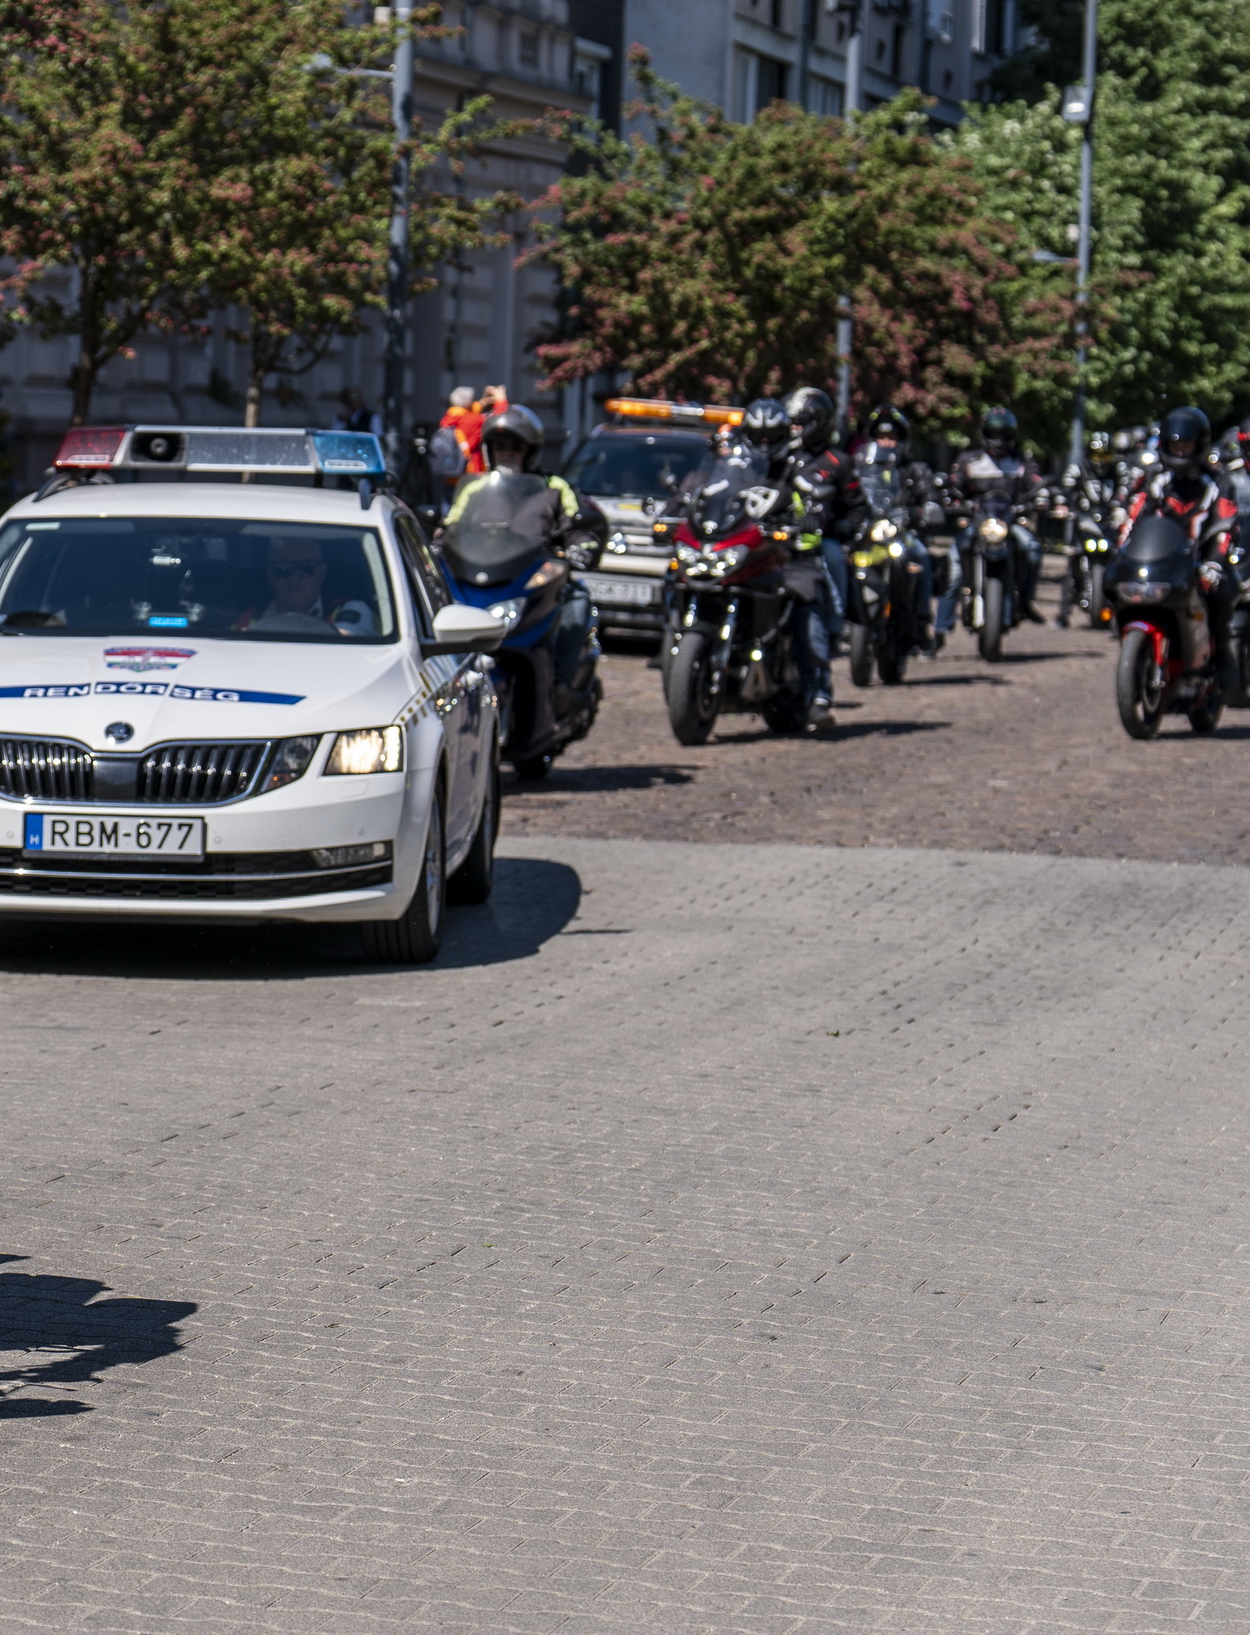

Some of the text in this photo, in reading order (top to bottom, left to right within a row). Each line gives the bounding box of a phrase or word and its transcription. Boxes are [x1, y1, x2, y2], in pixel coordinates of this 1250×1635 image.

[23, 682, 240, 701] RENDŐRSÉG
[29, 835, 40, 845] H
[50, 820, 194, 850] RBM-677
